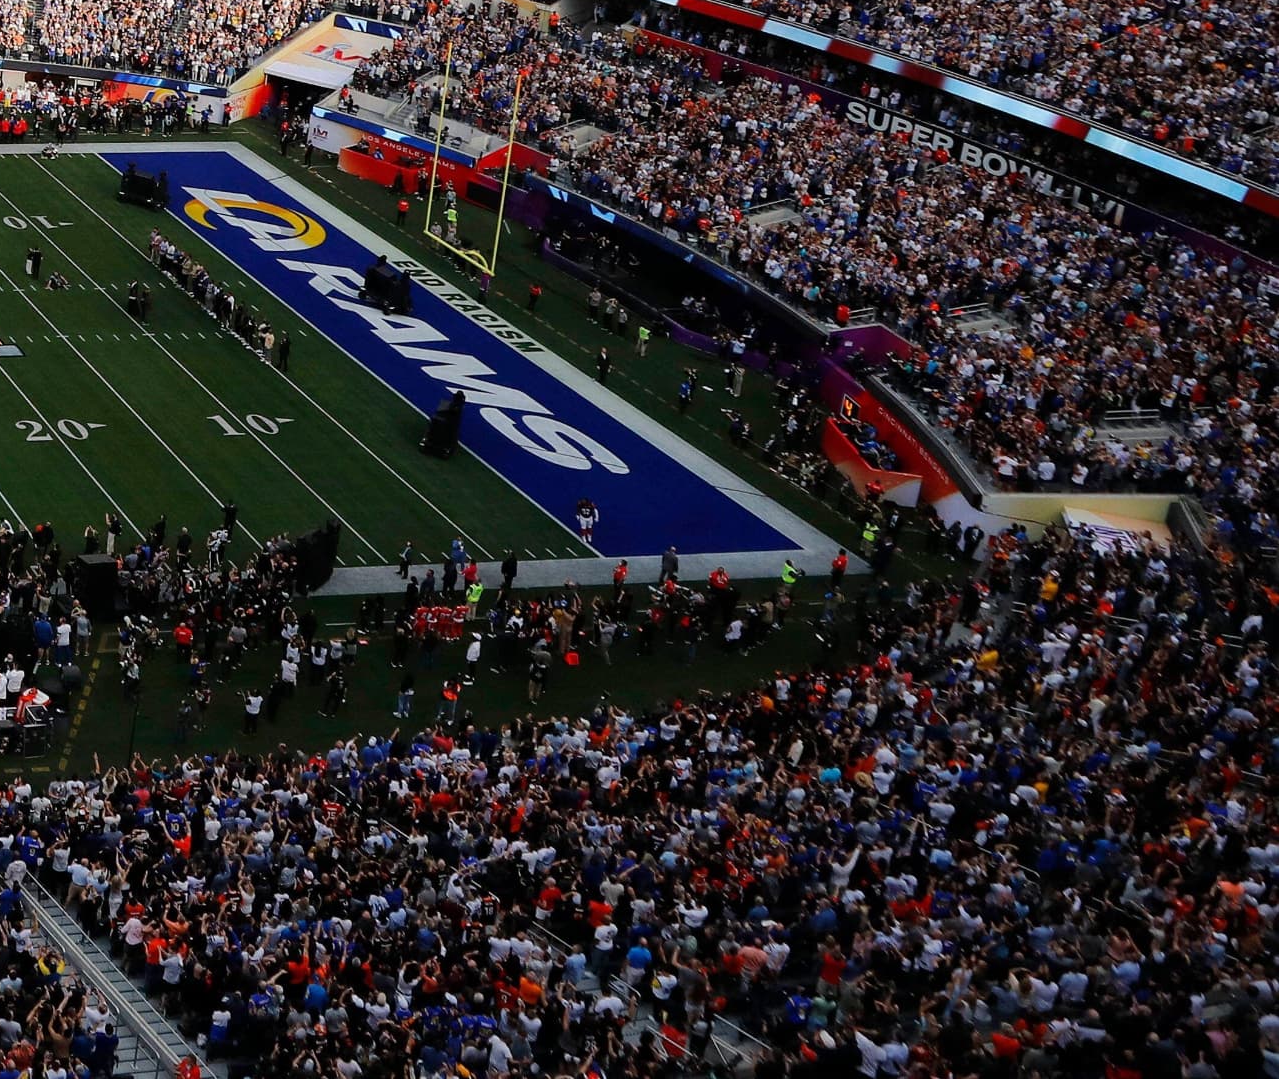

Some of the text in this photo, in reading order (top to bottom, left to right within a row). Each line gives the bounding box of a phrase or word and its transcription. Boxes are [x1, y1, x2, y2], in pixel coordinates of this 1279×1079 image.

[393, 259, 546, 354] END RACISM
[276, 257, 631, 476] RAMS
[14, 418, 93, 443] 20
[205, 412, 281, 438] 10
